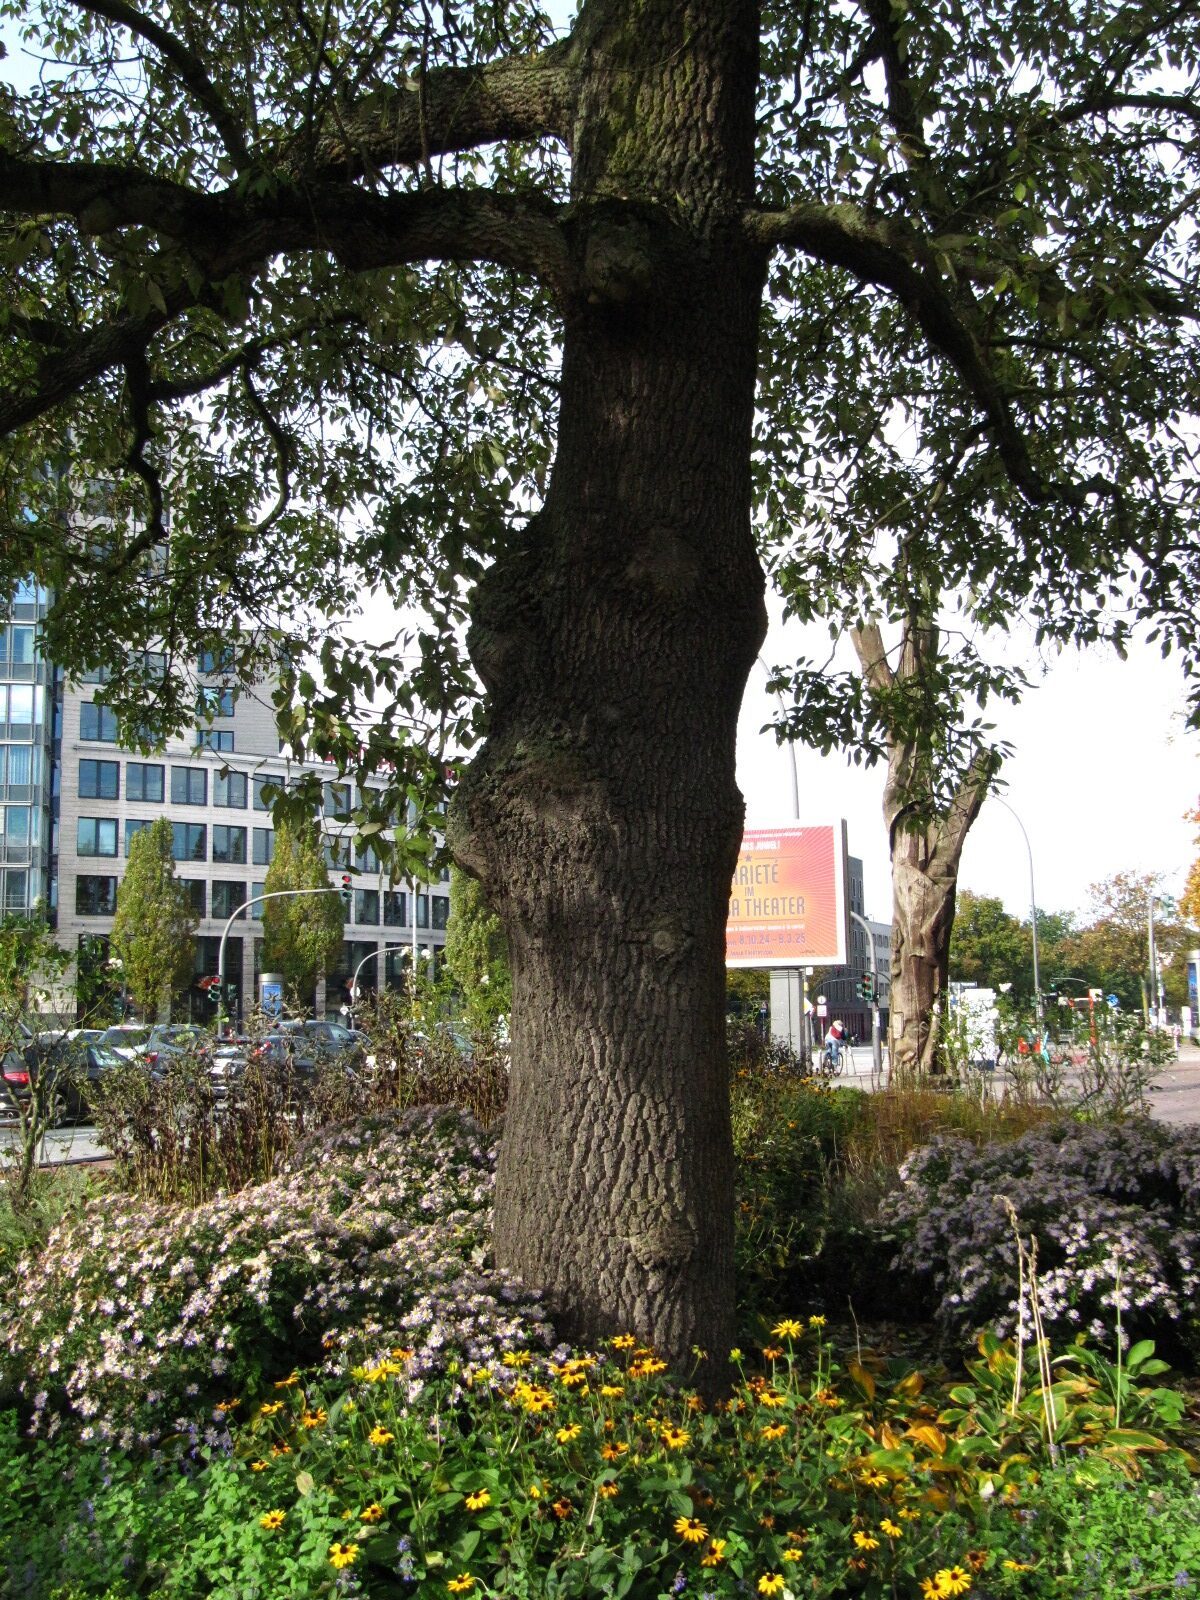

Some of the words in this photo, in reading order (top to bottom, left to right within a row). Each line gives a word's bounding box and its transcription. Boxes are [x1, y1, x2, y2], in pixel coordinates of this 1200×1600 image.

[732, 859, 779, 885] ARIETÉ
[745, 887, 754, 897] IM
[744, 896, 805, 917] THEATER
